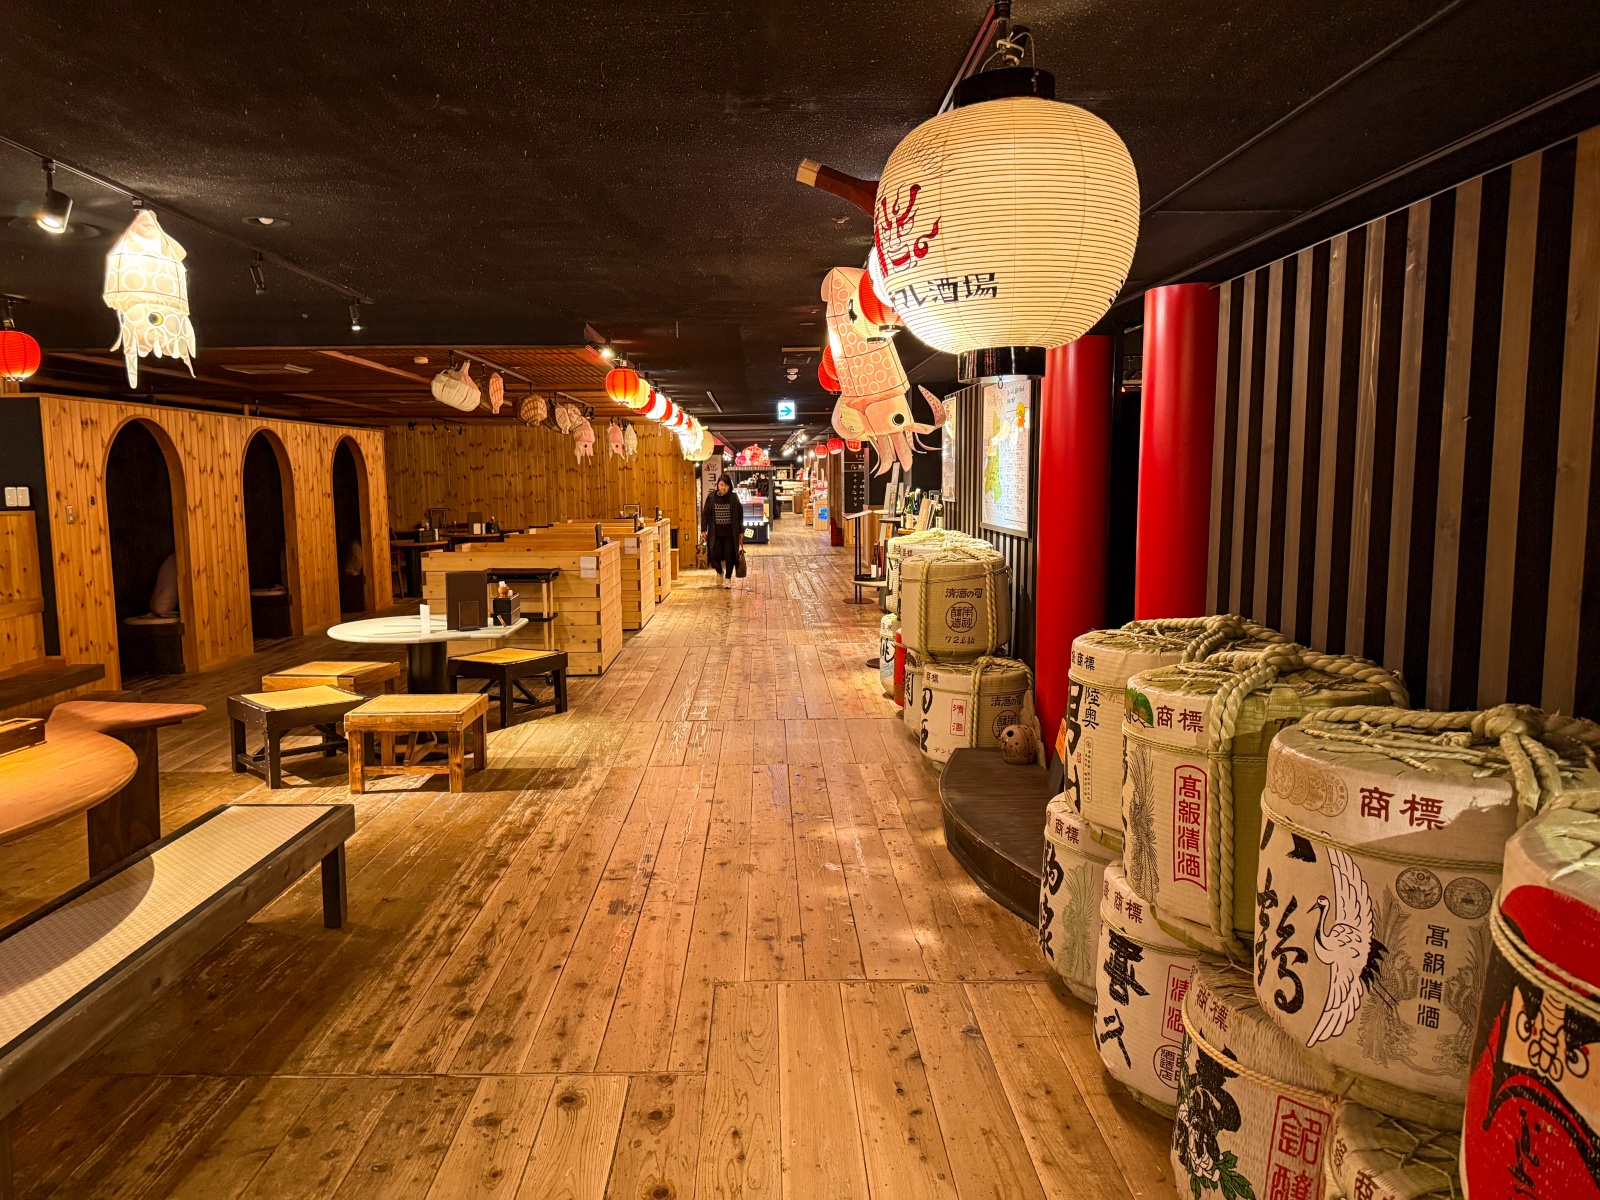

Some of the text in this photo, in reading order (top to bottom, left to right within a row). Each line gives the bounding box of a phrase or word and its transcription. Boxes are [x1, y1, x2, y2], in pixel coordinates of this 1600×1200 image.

[945, 588, 983, 599] 清酒の司
[952, 703, 965, 732] 清酒
[1082, 686, 1100, 730] 陸奥
[1156, 704, 1204, 734] 商標
[1359, 786, 1446, 831] 商標
[1166, 976, 1190, 1034] 清酒
